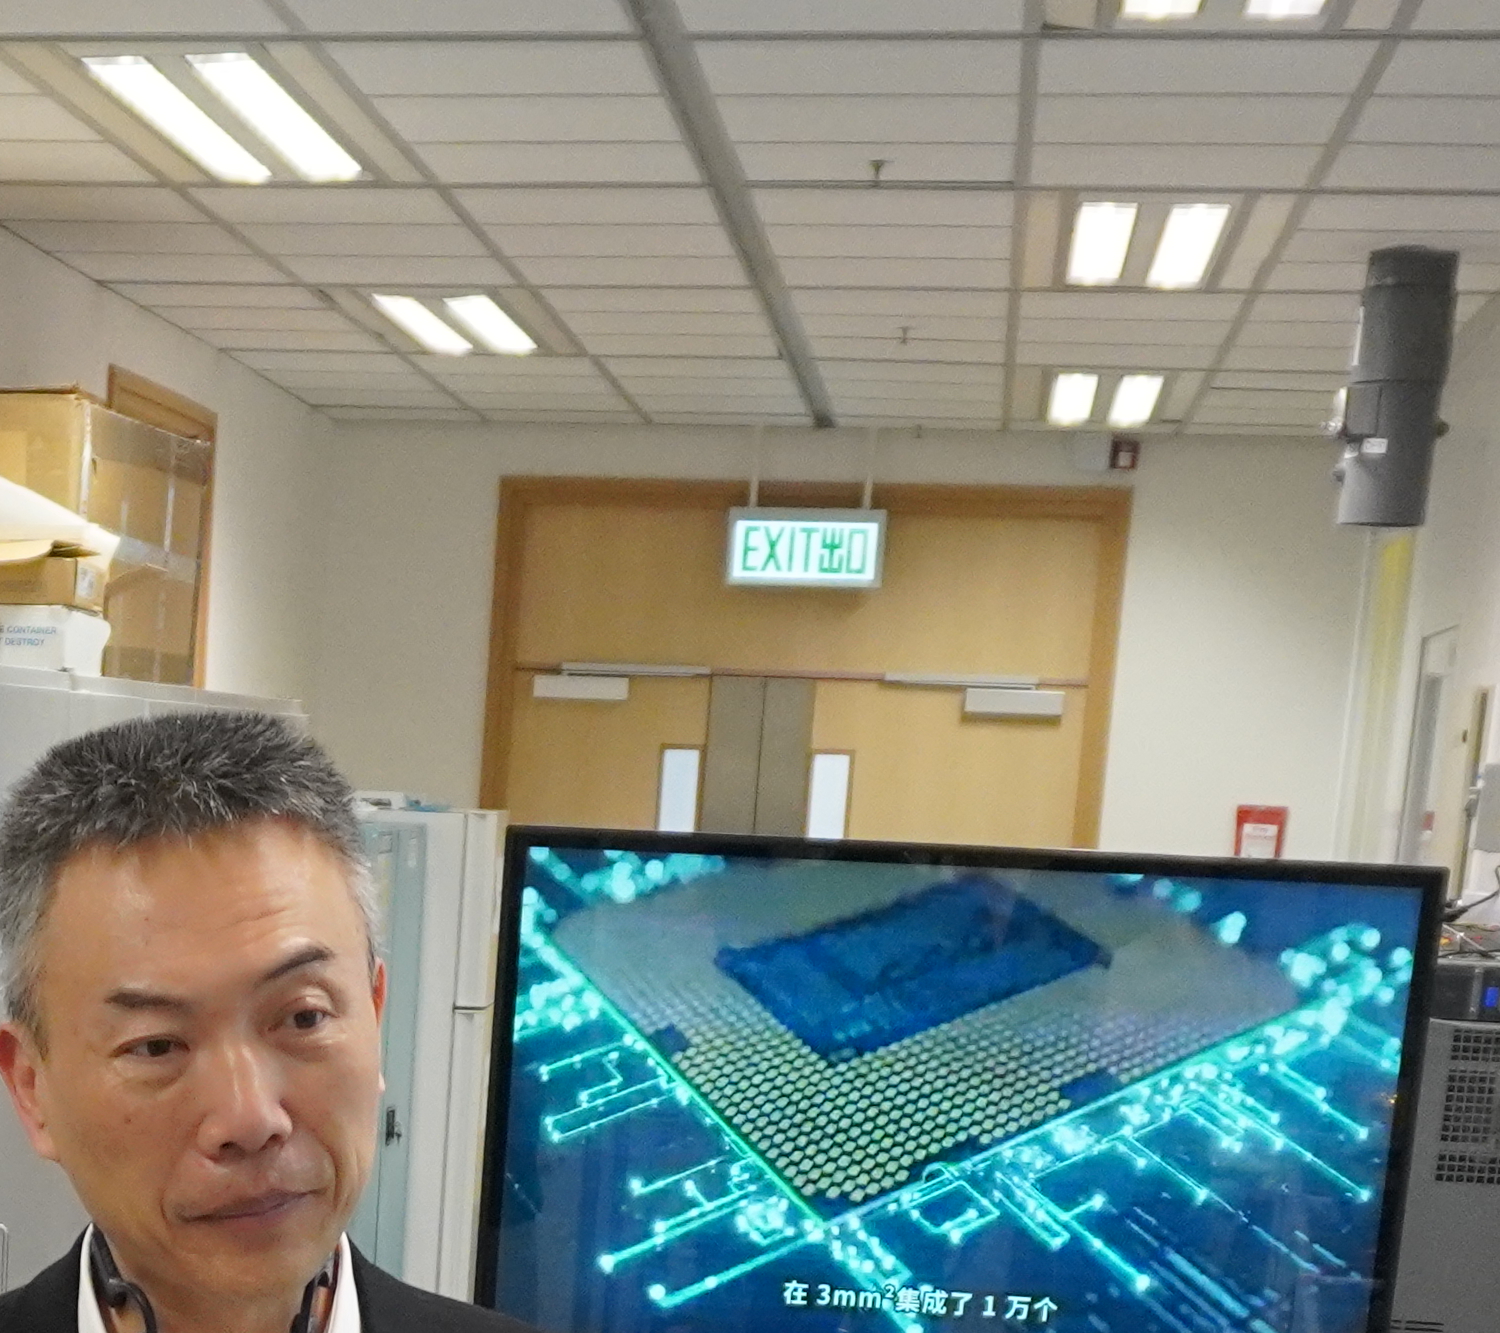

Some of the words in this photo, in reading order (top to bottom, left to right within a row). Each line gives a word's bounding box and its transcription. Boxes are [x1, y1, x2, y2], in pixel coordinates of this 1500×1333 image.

[742, 526, 820, 572] EXIT
[818, 528, 869, 574] 出口
[5, 637, 45, 646] DESTROY
[6, 625, 57, 635] CONTAINER
[783, 1280, 808, 1305] 在
[982, 1295, 996, 1317] 1
[1004, 1294, 1058, 1323] 万个
